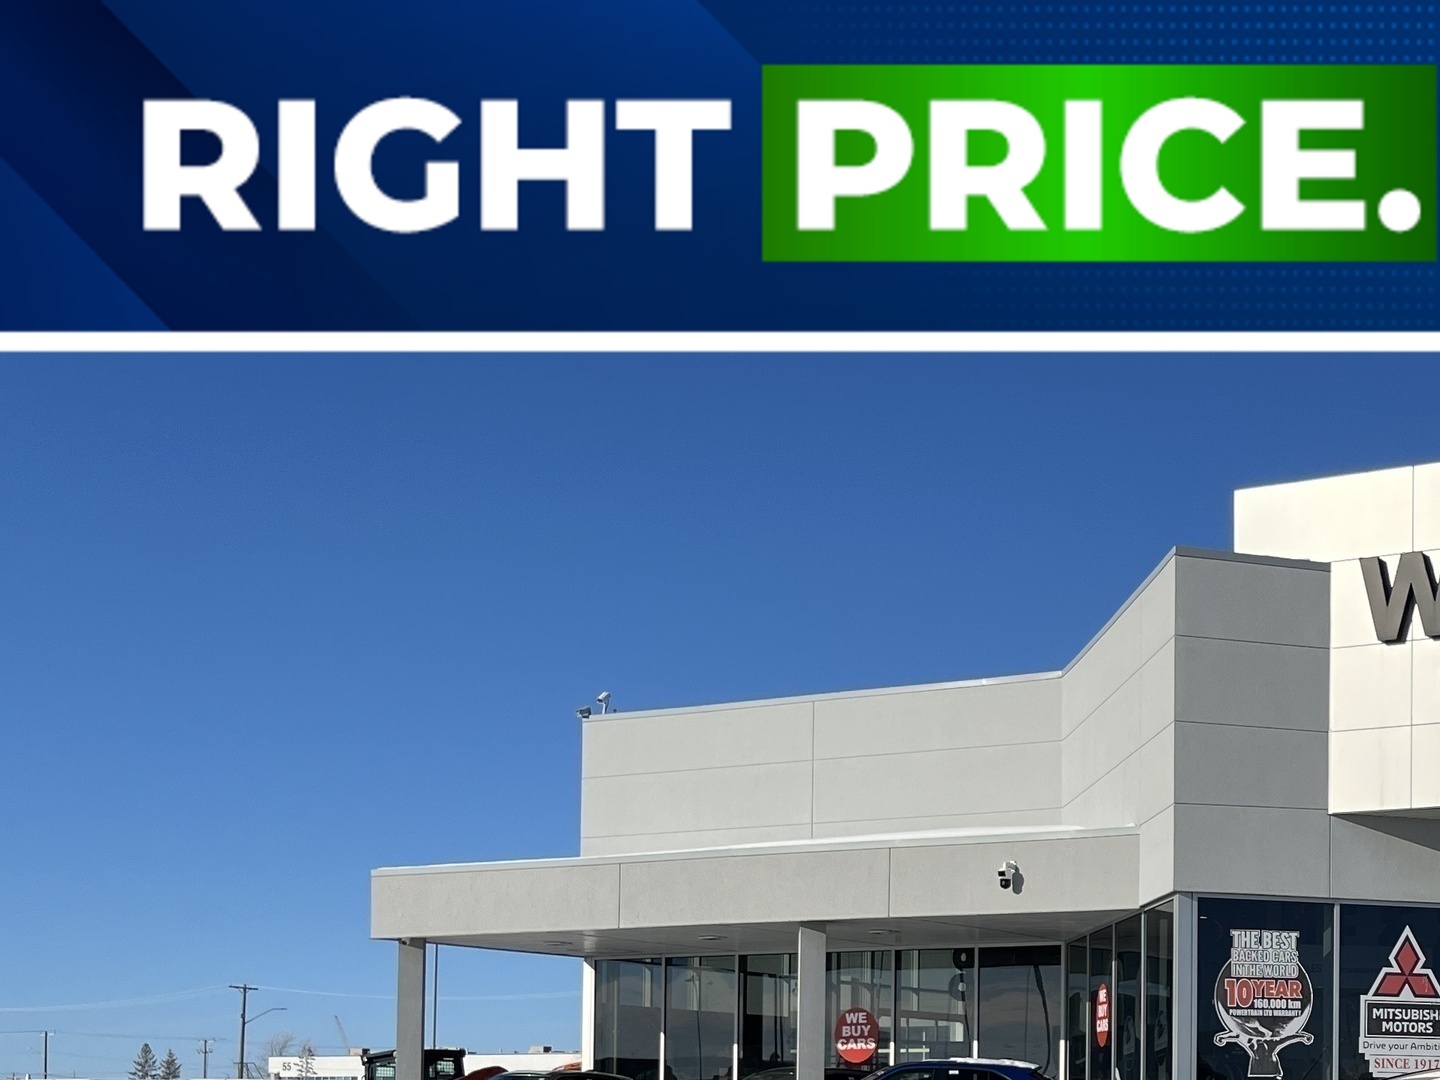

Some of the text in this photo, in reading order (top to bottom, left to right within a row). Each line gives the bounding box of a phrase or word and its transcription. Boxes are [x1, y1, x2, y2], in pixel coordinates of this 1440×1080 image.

[1230, 929, 1300, 950] THE BEST
[1231, 949, 1299, 963] BACKED CARS
[1232, 963, 1298, 978] IN THE WORLD
[1225, 978, 1302, 1008] 10 YEAR
[1254, 999, 1301, 1010] 160,000 km
[845, 1012, 867, 1024] WE
[842, 1025, 871, 1037] BUY
[1382, 1021, 1434, 1034] MOTORS
[837, 1038, 876, 1051] CARS
[1363, 1041, 1386, 1050] Drive
[1388, 1044, 1408, 1052] your
[282, 1061, 292, 1071] 55
[1374, 1058, 1440, 1070] SINCE 1917
